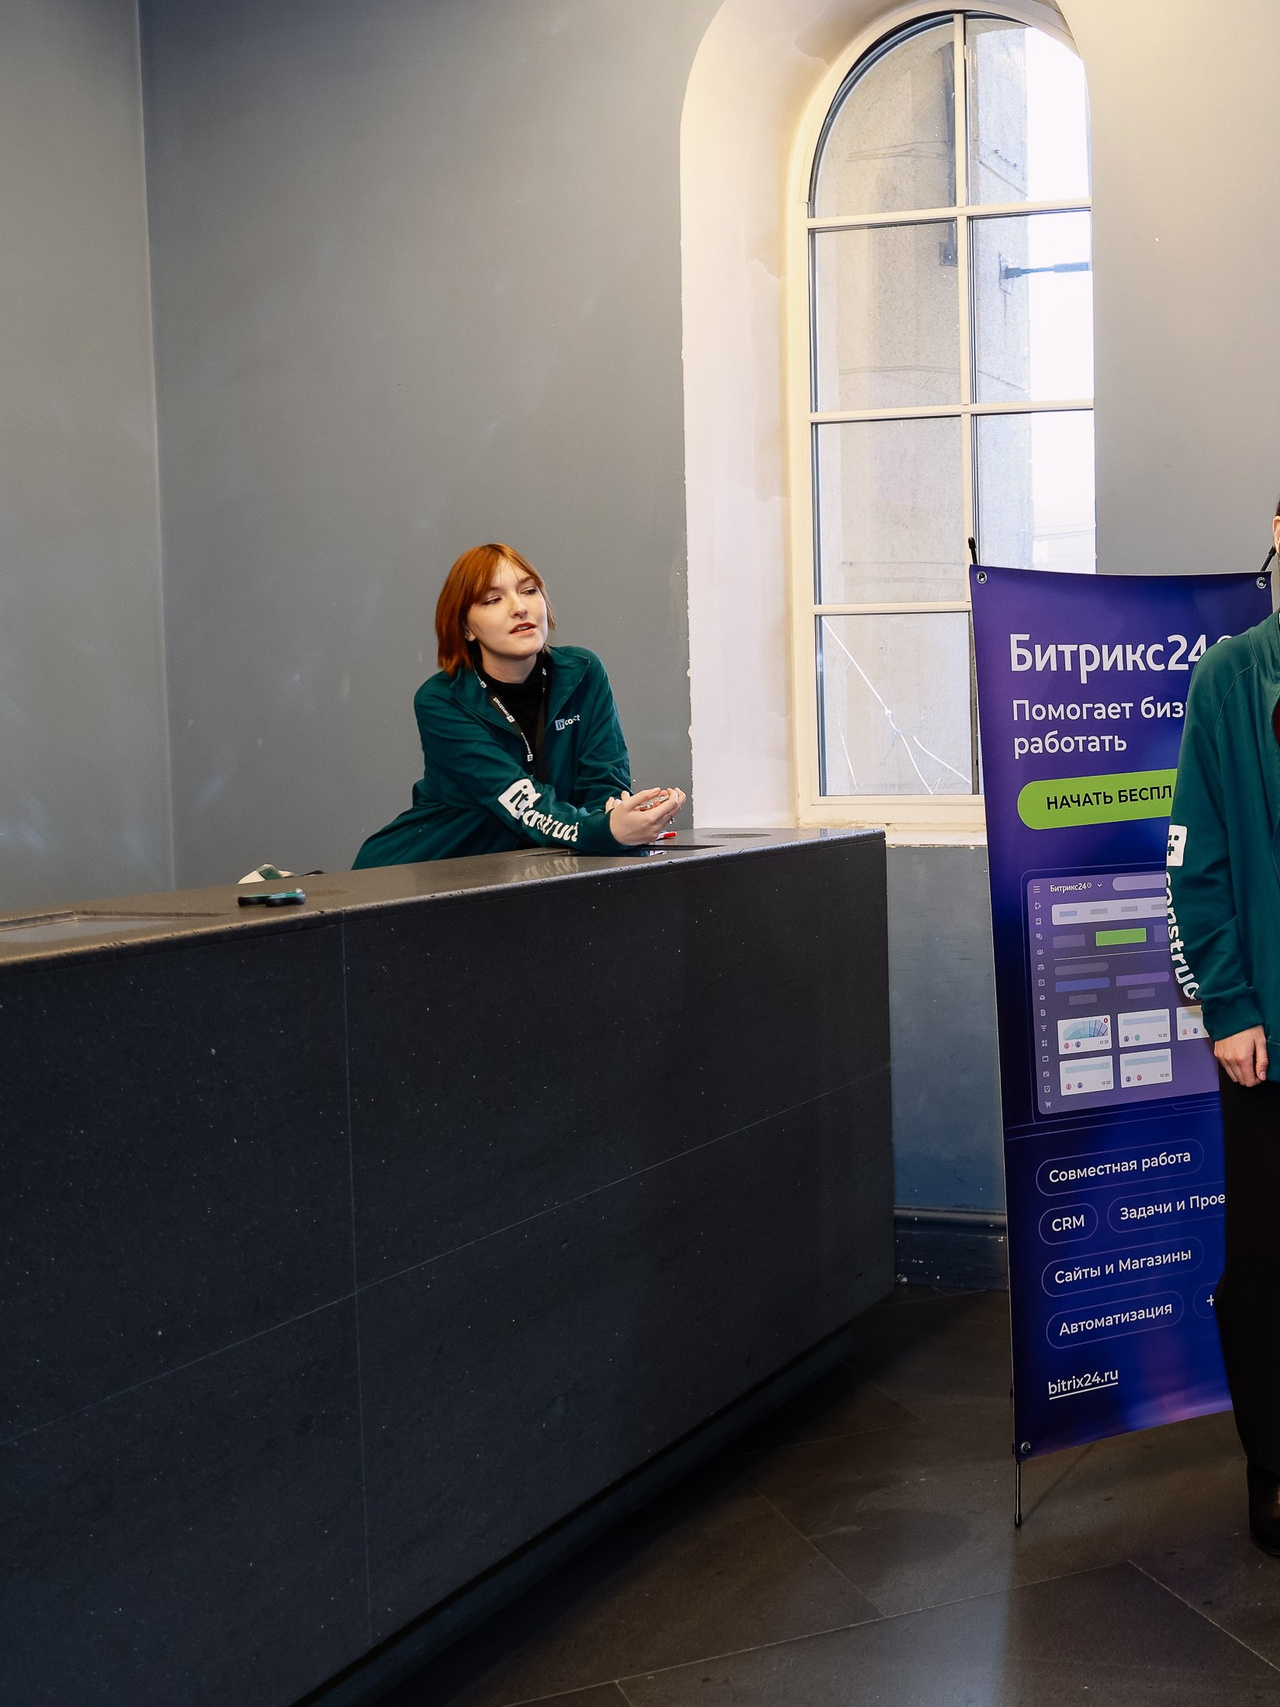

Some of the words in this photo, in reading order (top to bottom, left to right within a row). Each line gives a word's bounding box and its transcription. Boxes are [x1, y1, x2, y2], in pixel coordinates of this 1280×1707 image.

[1010, 634, 1206, 684] Битрикс24
[1013, 699, 1133, 722] Помогает
[1140, 696, 1187, 719] биз
[1014, 730, 1127, 760] работать
[1046, 791, 1114, 811] НАЧАТЬ
[1118, 785, 1172, 803] БЕСПЛ
[1050, 882, 1087, 894] Битрикс24
[1049, 1159, 1137, 1183] Совместная
[1142, 1151, 1191, 1172] работа
[1120, 1202, 1172, 1221] Задачи
[1176, 1200, 1186, 1212] и
[1189, 1192, 1226, 1210] Прое
[1051, 1214, 1085, 1232] CRM
[1054, 1267, 1101, 1285] Сайты
[1105, 1264, 1114, 1275] и
[1118, 1249, 1192, 1273] Магазины
[1059, 1303, 1173, 1336] Автоматизация
[1048, 1369, 1119, 1396] bitrix24.ru
